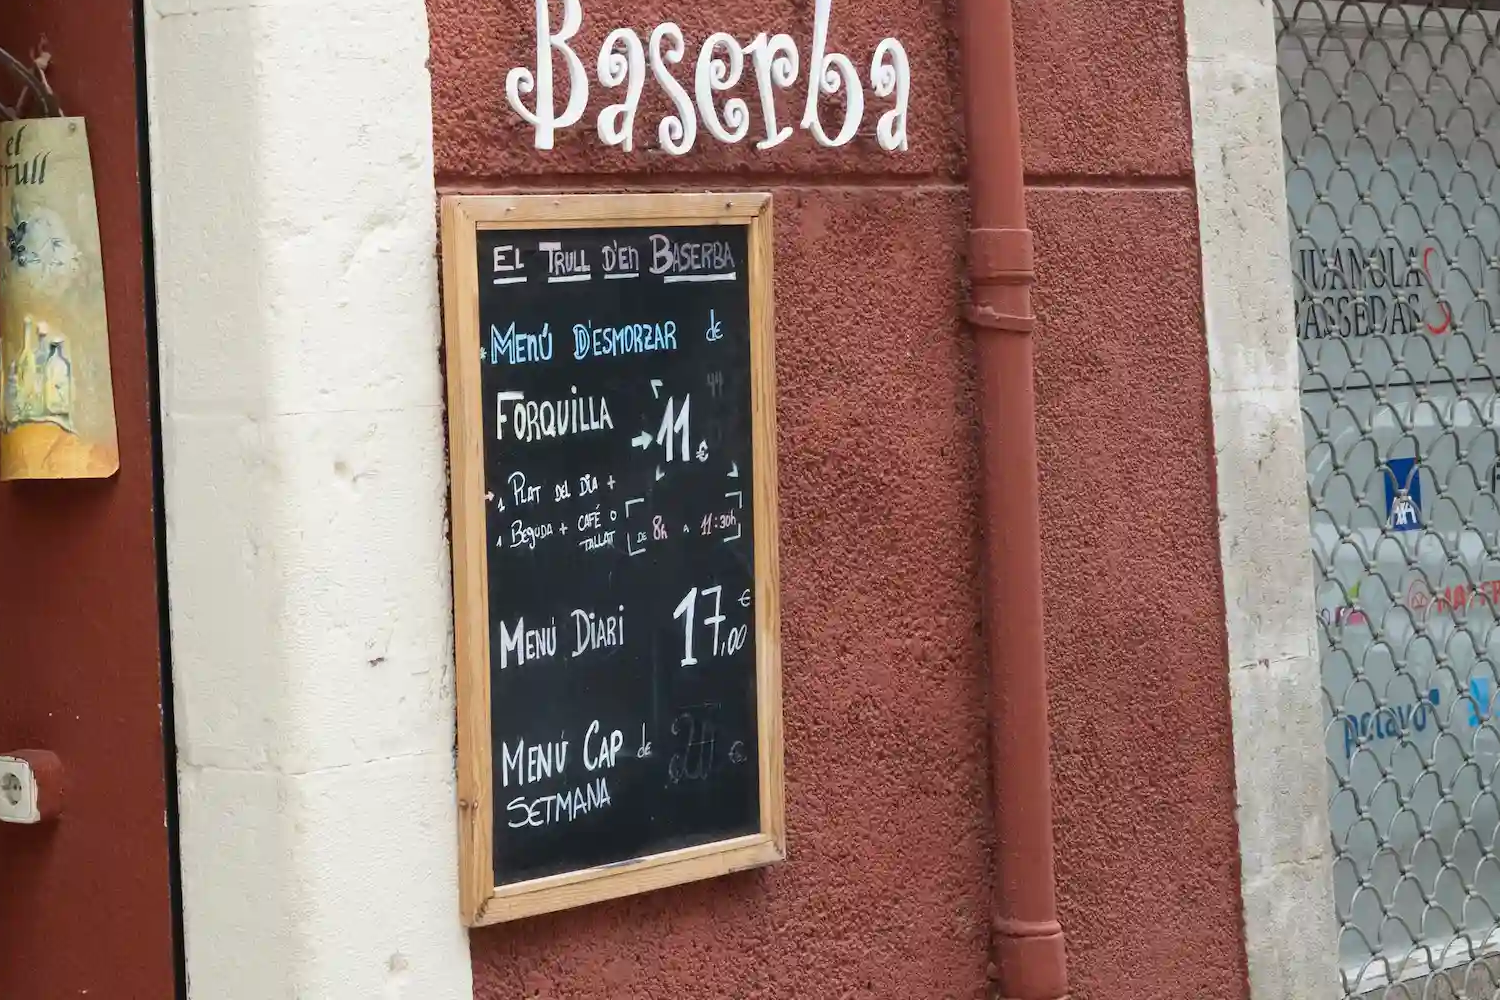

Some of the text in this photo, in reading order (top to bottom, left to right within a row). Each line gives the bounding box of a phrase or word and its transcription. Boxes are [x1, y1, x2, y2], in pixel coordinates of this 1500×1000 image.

[6, 124, 28, 156] el
[538, 241, 591, 276] TRULL
[649, 233, 736, 276] BASERBA
[496, 385, 615, 442] FORQUILLA
[508, 470, 541, 506] PLAT
[584, 719, 624, 771] CAP
[507, 777, 612, 829] SETMANA
